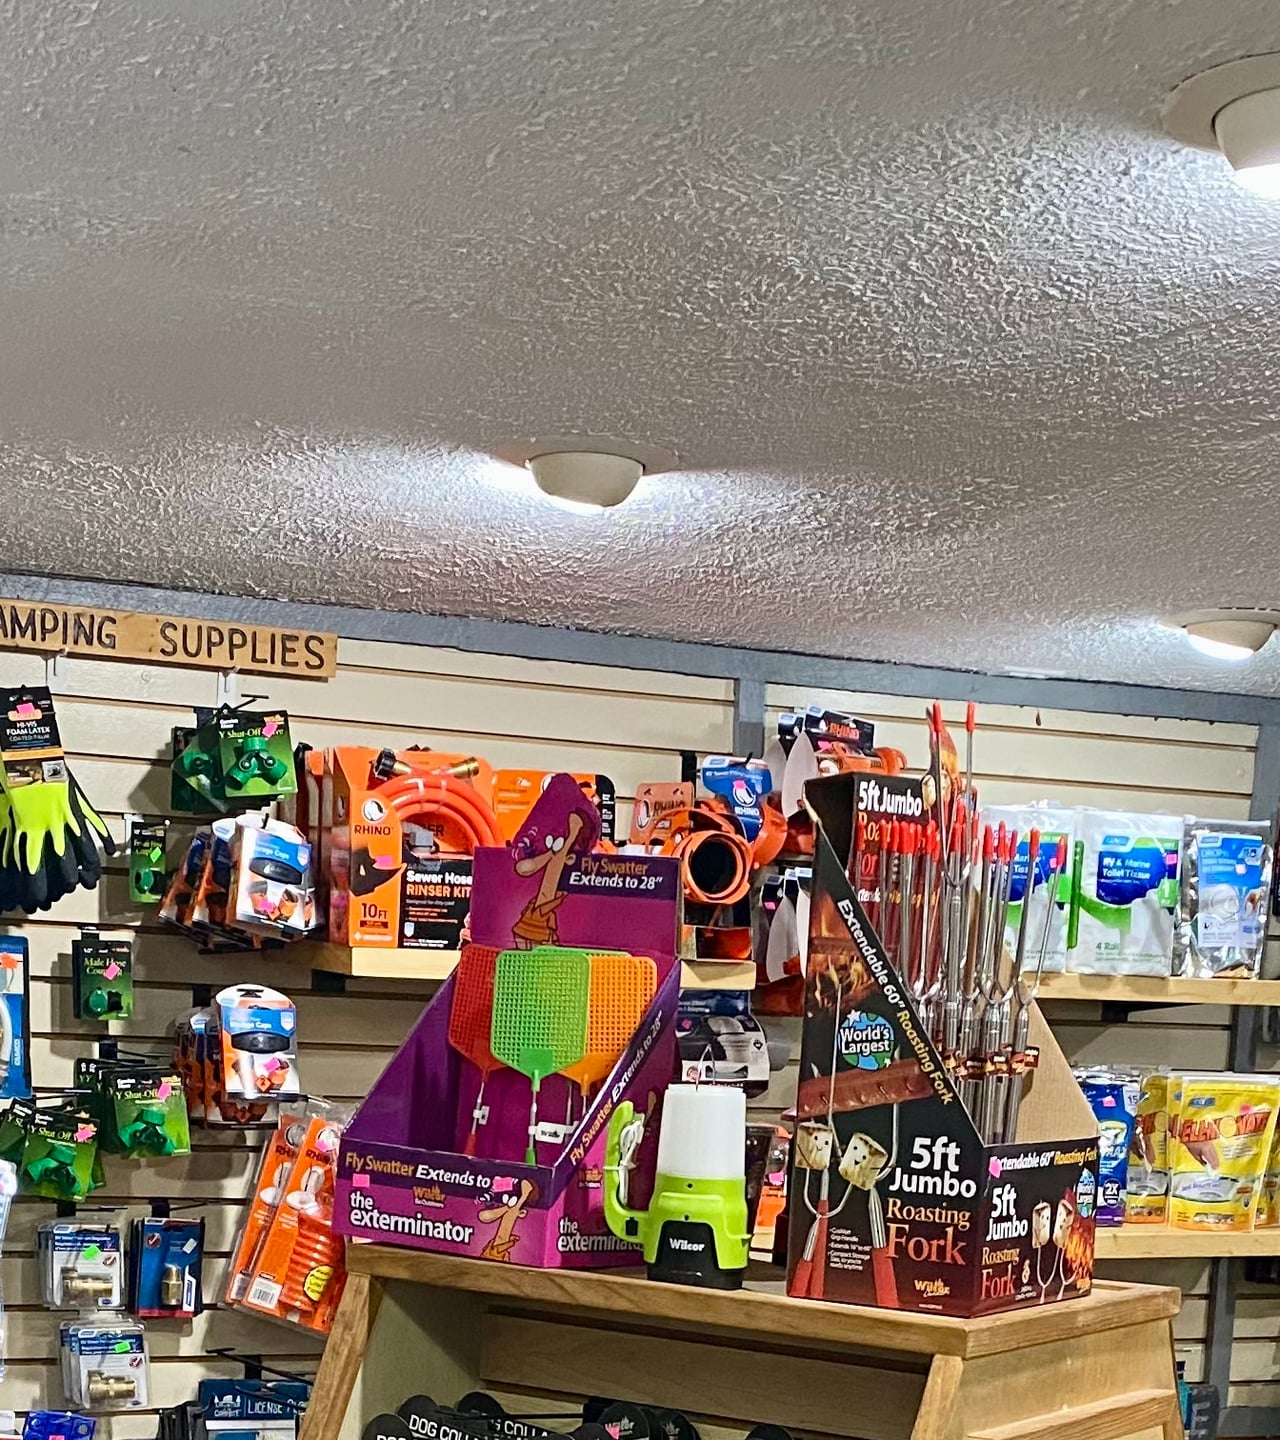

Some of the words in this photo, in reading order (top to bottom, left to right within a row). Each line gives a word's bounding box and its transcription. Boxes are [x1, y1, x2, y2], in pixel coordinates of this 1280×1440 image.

[158, 621, 325, 670] SUPPLIES
[880, 786, 922, 817] Jumbo
[354, 825, 392, 836] RHINO
[406, 870, 442, 884] Sewer
[602, 859, 648, 875] Swatter
[406, 884, 451, 898] RINSER
[569, 872, 623, 888] Extends
[625, 876, 637, 889] to
[836, 898, 888, 986] Extendable
[895, 1009, 934, 1073] Roasting
[840, 1025, 890, 1043] World's
[840, 1039, 890, 1055] Largest
[570, 1145, 586, 1166] Fly
[910, 1135, 961, 1172] 5ft
[345, 1152, 363, 1172] Fly
[365, 1156, 415, 1177] Swatter
[415, 1164, 474, 1187] Extends
[476, 1173, 491, 1189] to
[889, 1167, 977, 1199] Jumbo
[350, 1192, 374, 1211] the
[991, 1183, 1017, 1218] 5ft
[886, 1198, 971, 1231] Roasting
[350, 1209, 474, 1244] exterminator
[986, 1217, 1029, 1242] Jumbo
[669, 1238, 705, 1252] Wilcor
[886, 1221, 966, 1266] Fork
[982, 1246, 1020, 1266] Roasting
[981, 1262, 1016, 1300] Fork
[248, 1402, 283, 1415] LICENSE
